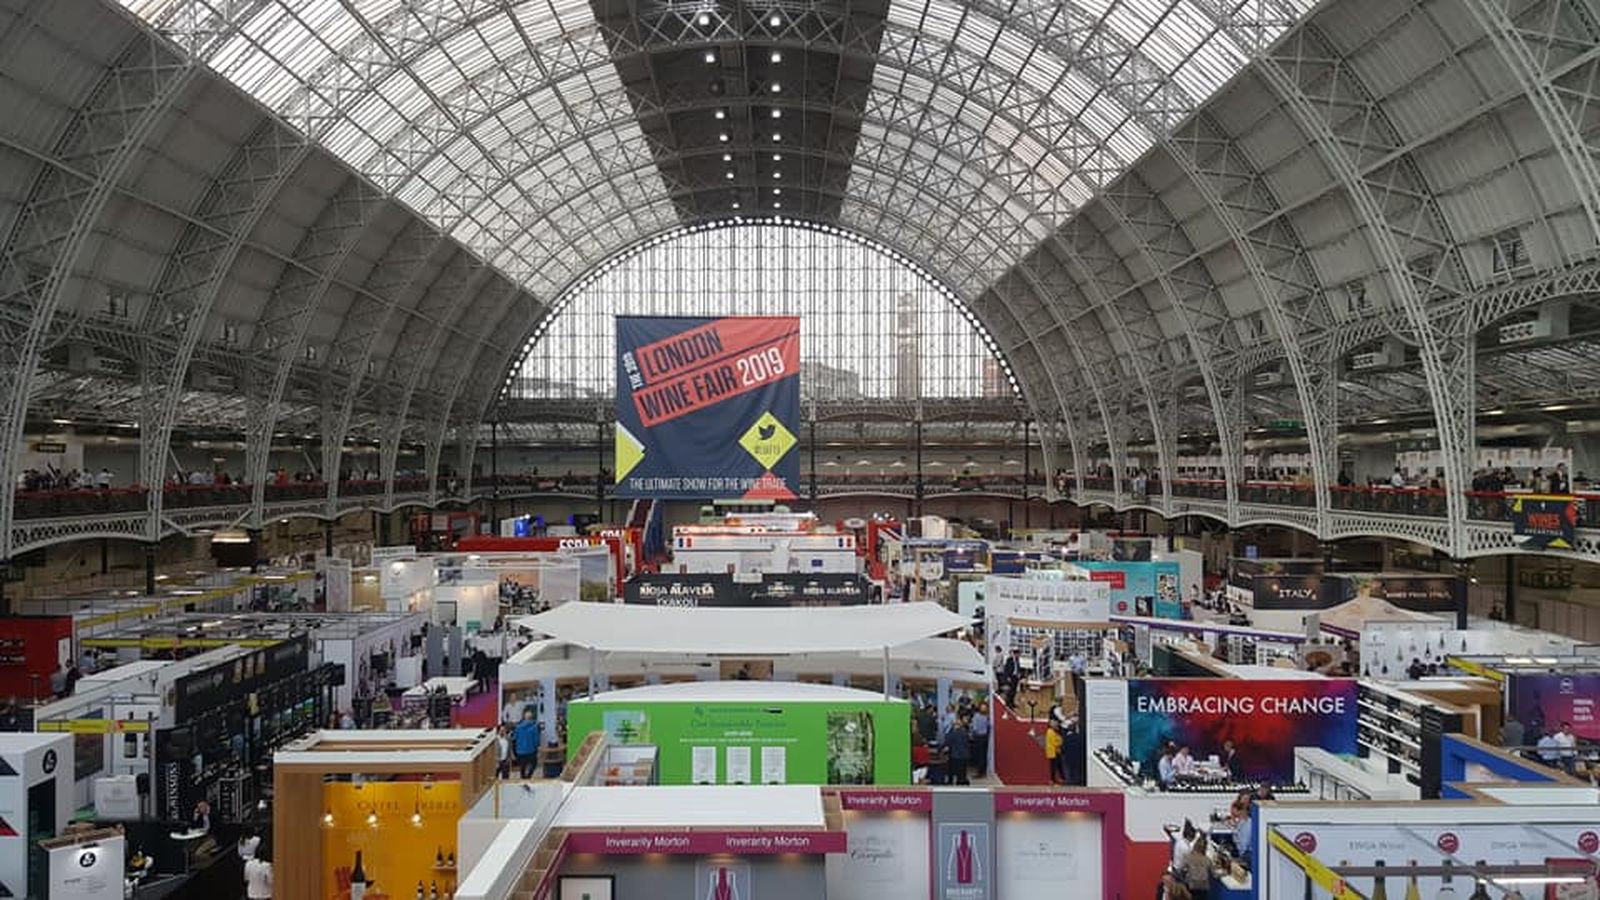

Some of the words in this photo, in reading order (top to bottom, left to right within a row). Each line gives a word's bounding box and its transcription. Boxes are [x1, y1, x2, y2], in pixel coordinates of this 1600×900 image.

[642, 328, 724, 377] LONDON
[639, 386, 695, 421] WINE
[694, 365, 739, 402] FAIR
[737, 347, 786, 387] 2019
[629, 478, 643, 490] THE
[644, 478, 682, 490] ULTIMATE
[682, 478, 707, 490] SHOW
[708, 478, 724, 490] FOR
[725, 478, 740, 490] THE
[741, 478, 761, 490] WINE
[762, 478, 788, 490] TRADE
[640, 586, 668, 597] RIOJA
[670, 586, 715, 596] ALAVESA
[1279, 588, 1313, 599] ITALY
[1137, 696, 1255, 714] EMBRACING
[1260, 696, 1346, 714] CHANGE
[846, 796, 888, 806] Inverarity
[890, 795, 922, 805] Morton
[1013, 796, 1056, 807] Inverarity
[1057, 796, 1090, 806] Morton
[606, 837, 652, 848] Inverarity
[654, 836, 690, 847] Morton
[726, 837, 772, 848] Inverarity
[774, 836, 810, 846] Morton
